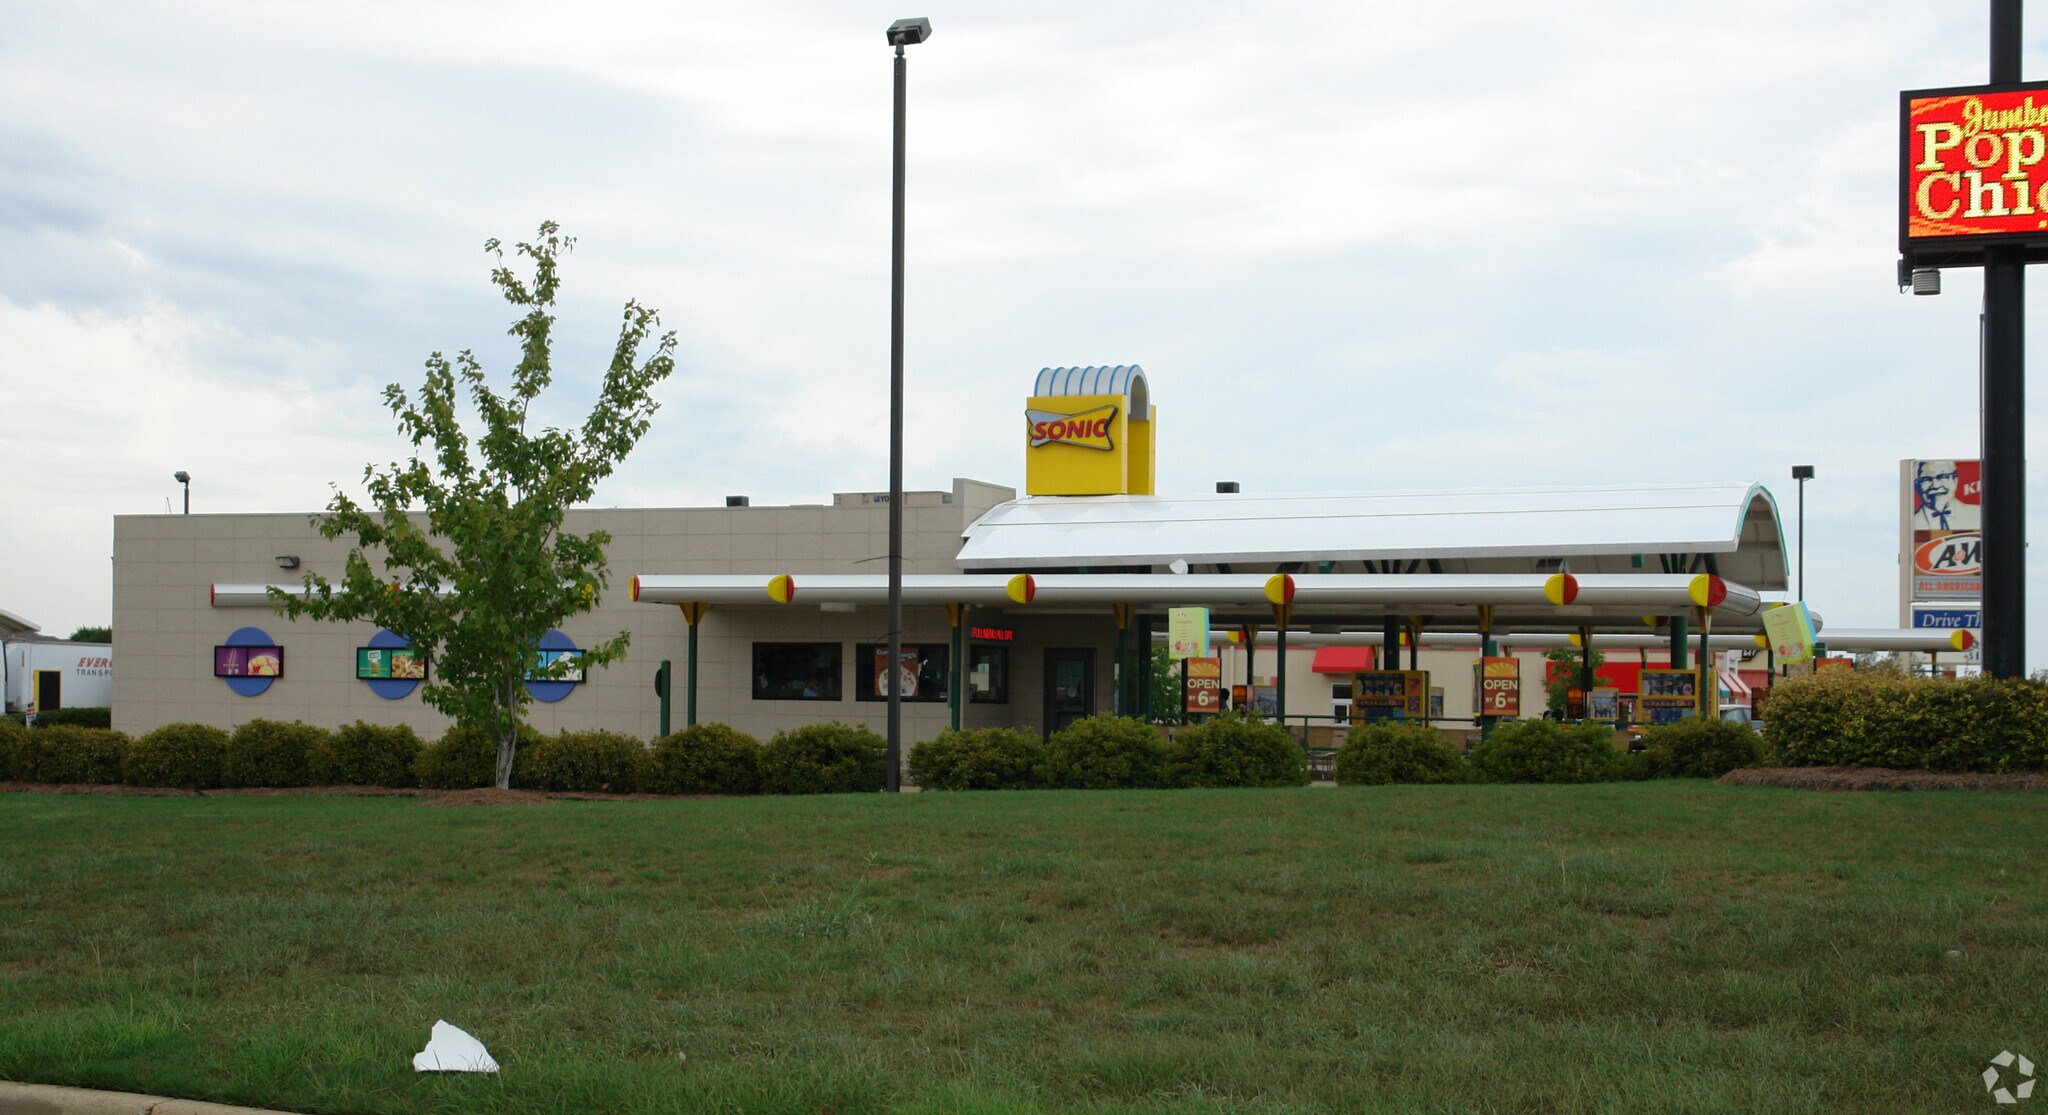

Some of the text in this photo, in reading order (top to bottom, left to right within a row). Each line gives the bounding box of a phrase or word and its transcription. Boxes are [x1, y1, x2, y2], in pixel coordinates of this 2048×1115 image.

[1032, 418, 1108, 441] SONIC
[1918, 580, 1933, 592] ALL
[1922, 612, 1961, 628] Drive
[1187, 678, 1220, 689] OPEN
[1483, 679, 1518, 690] OPEN
[1197, 690, 1209, 706] 6
[1495, 691, 1506, 708] 6
